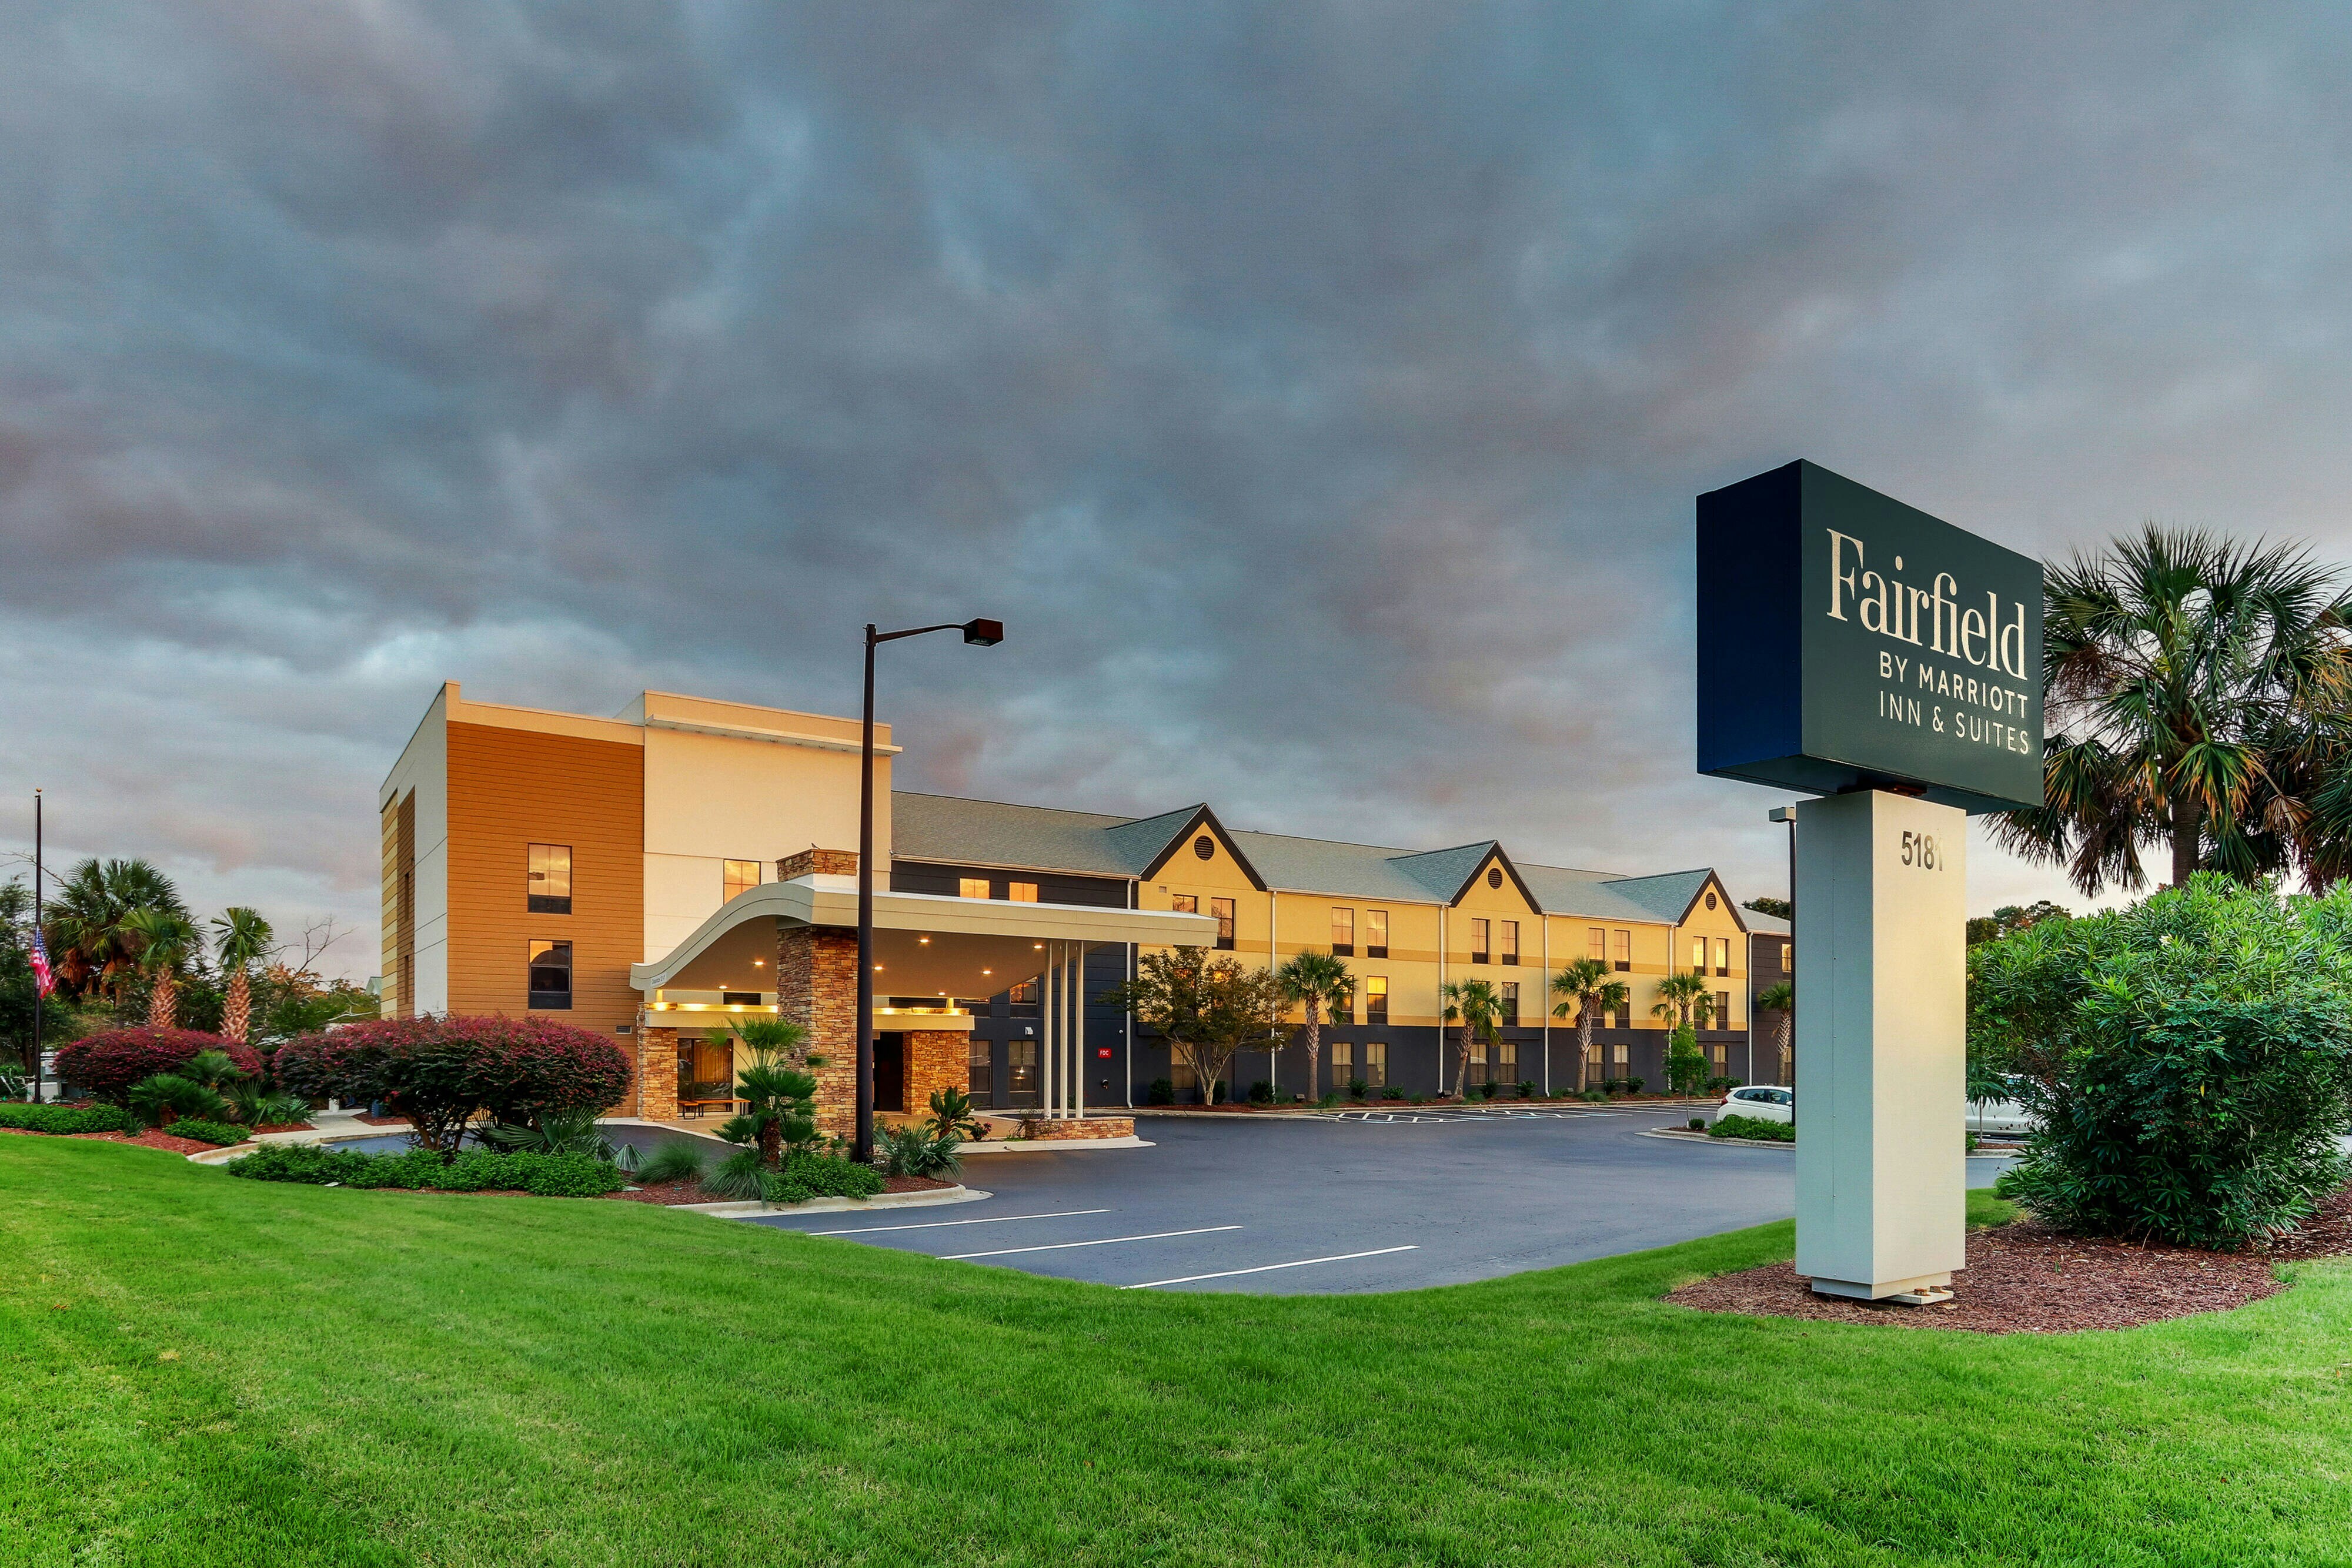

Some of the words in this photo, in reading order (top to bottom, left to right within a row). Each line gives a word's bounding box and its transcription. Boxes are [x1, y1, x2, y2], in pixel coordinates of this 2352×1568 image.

[1826, 527, 2028, 681] Fairfield
[1880, 650, 1908, 683] BY
[1919, 663, 2028, 718] MARRIOTT
[1880, 690, 1920, 727] INN
[1932, 706, 1945, 733] &
[1955, 711, 2029, 755] SUITES
